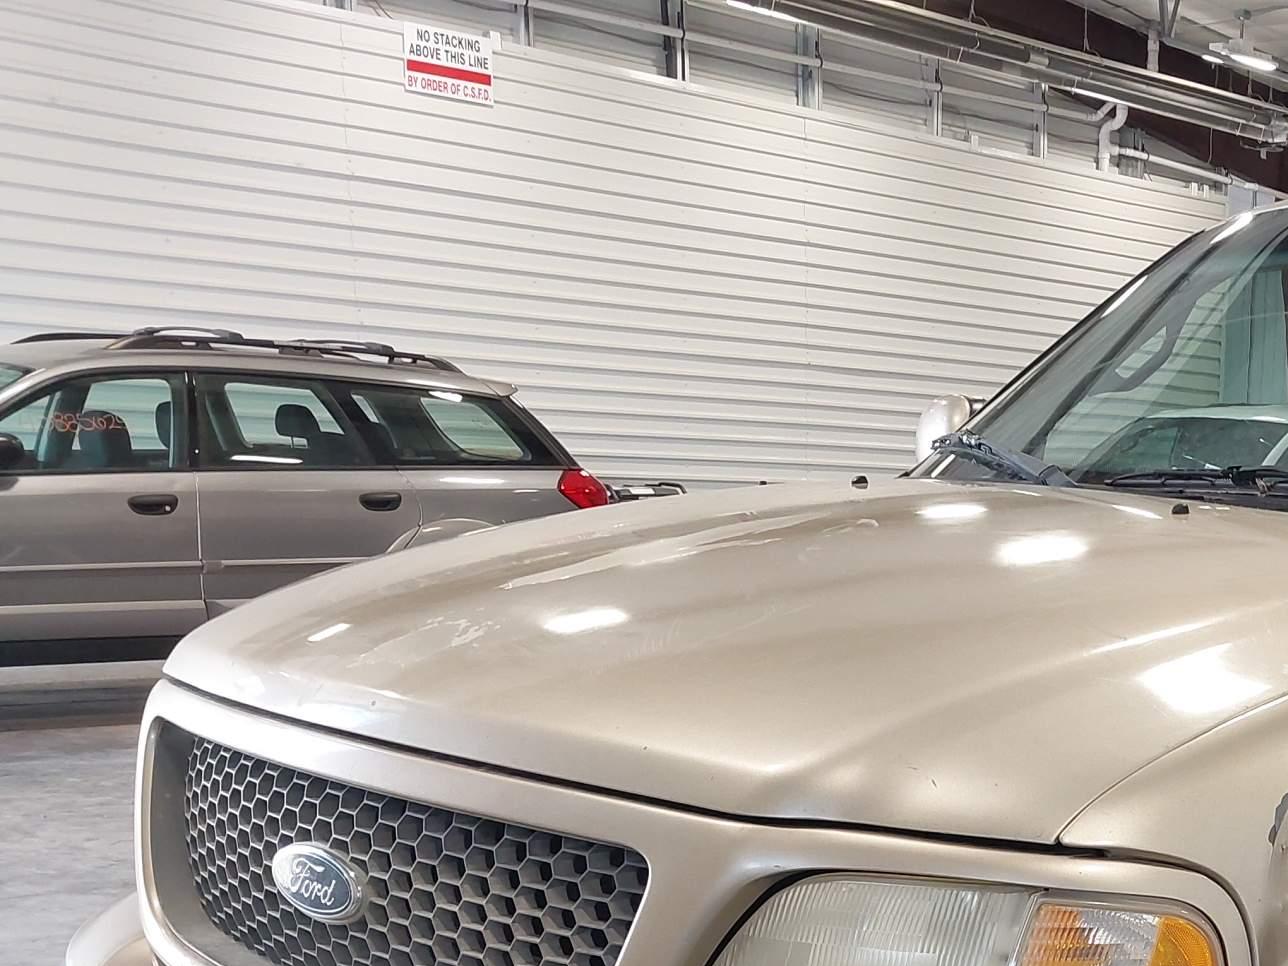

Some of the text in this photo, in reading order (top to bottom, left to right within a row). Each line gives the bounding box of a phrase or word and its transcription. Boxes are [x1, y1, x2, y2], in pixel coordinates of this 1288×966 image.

[417, 28, 481, 53] NO STACKING
[409, 43, 489, 70] ABOVE THIS LINE
[408, 75, 492, 102] BY ORDER OF C.S.F.D.
[290, 857, 336, 906] Ford
